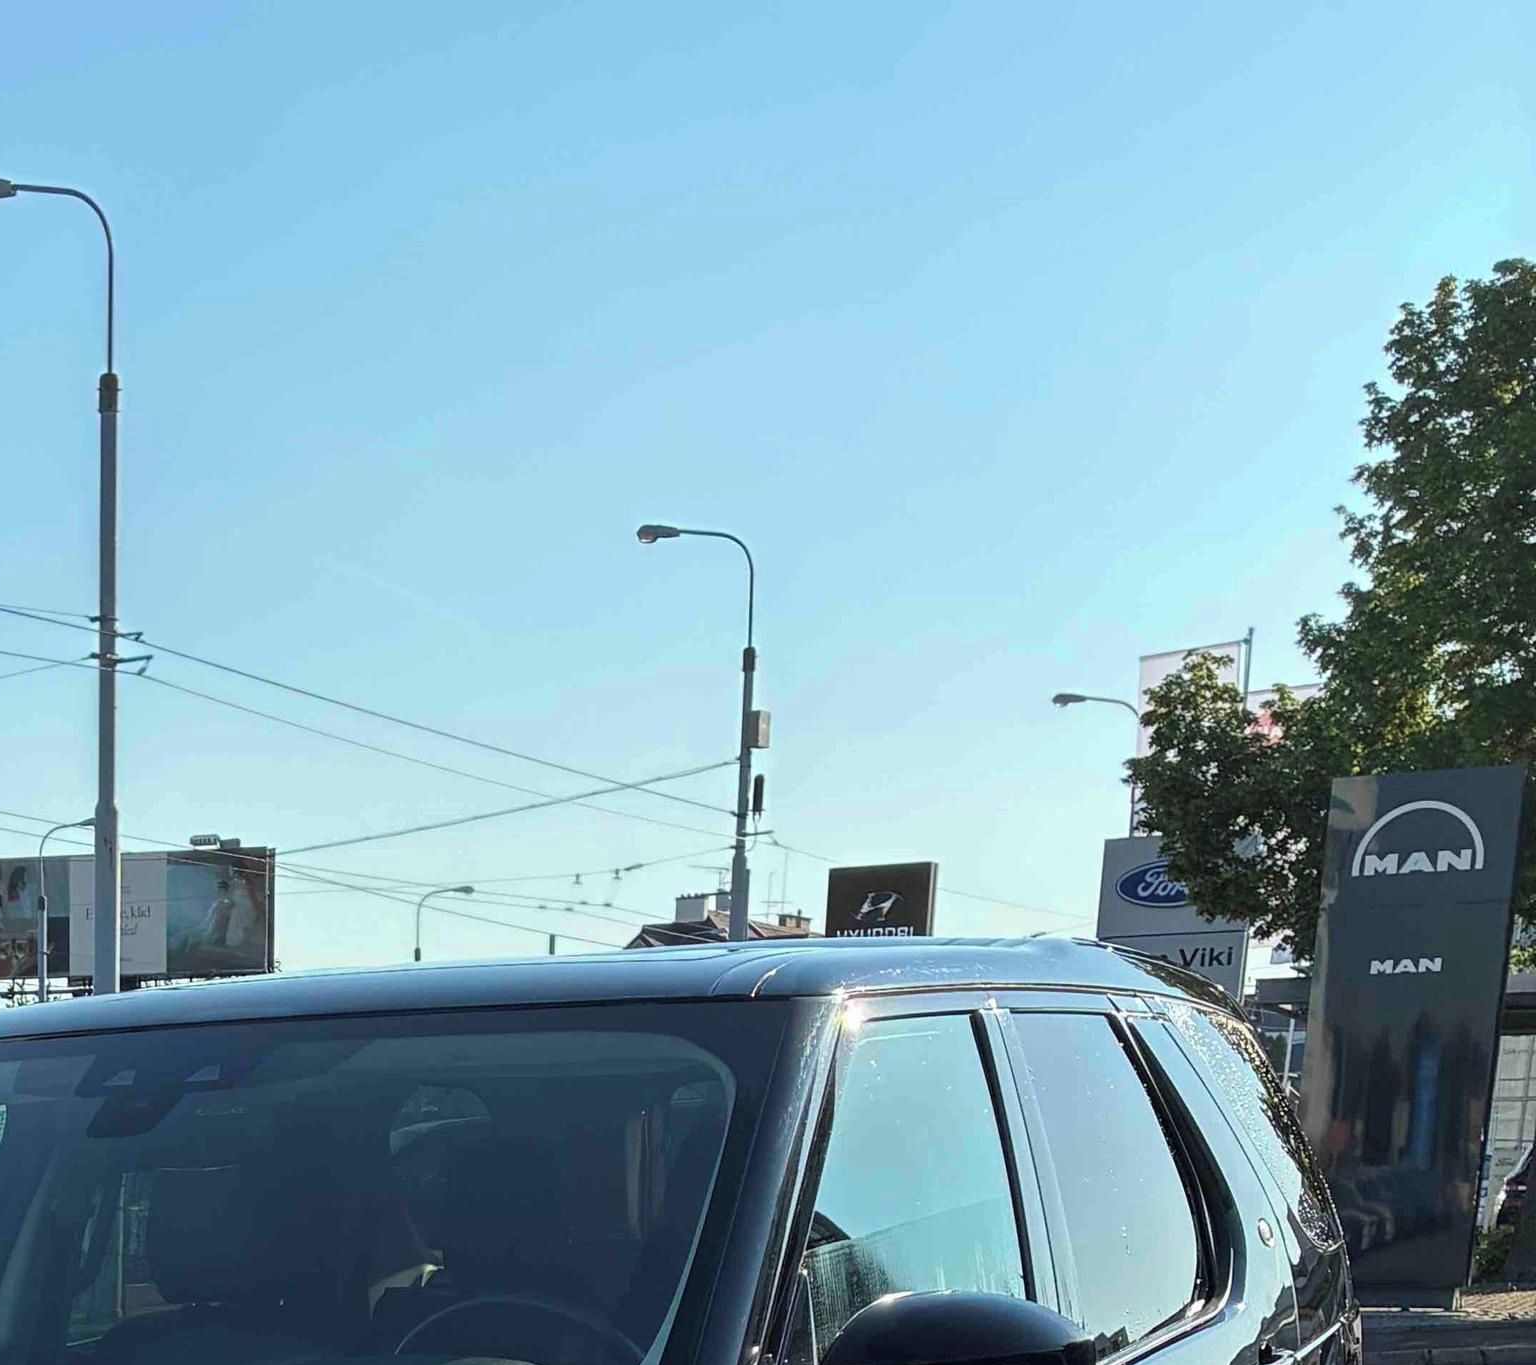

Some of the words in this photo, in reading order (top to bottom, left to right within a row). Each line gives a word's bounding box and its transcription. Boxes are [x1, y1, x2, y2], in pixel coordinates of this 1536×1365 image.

[1364, 849, 1473, 876] MAN
[1178, 946, 1234, 967] Viki
[1370, 957, 1443, 975] MAN
